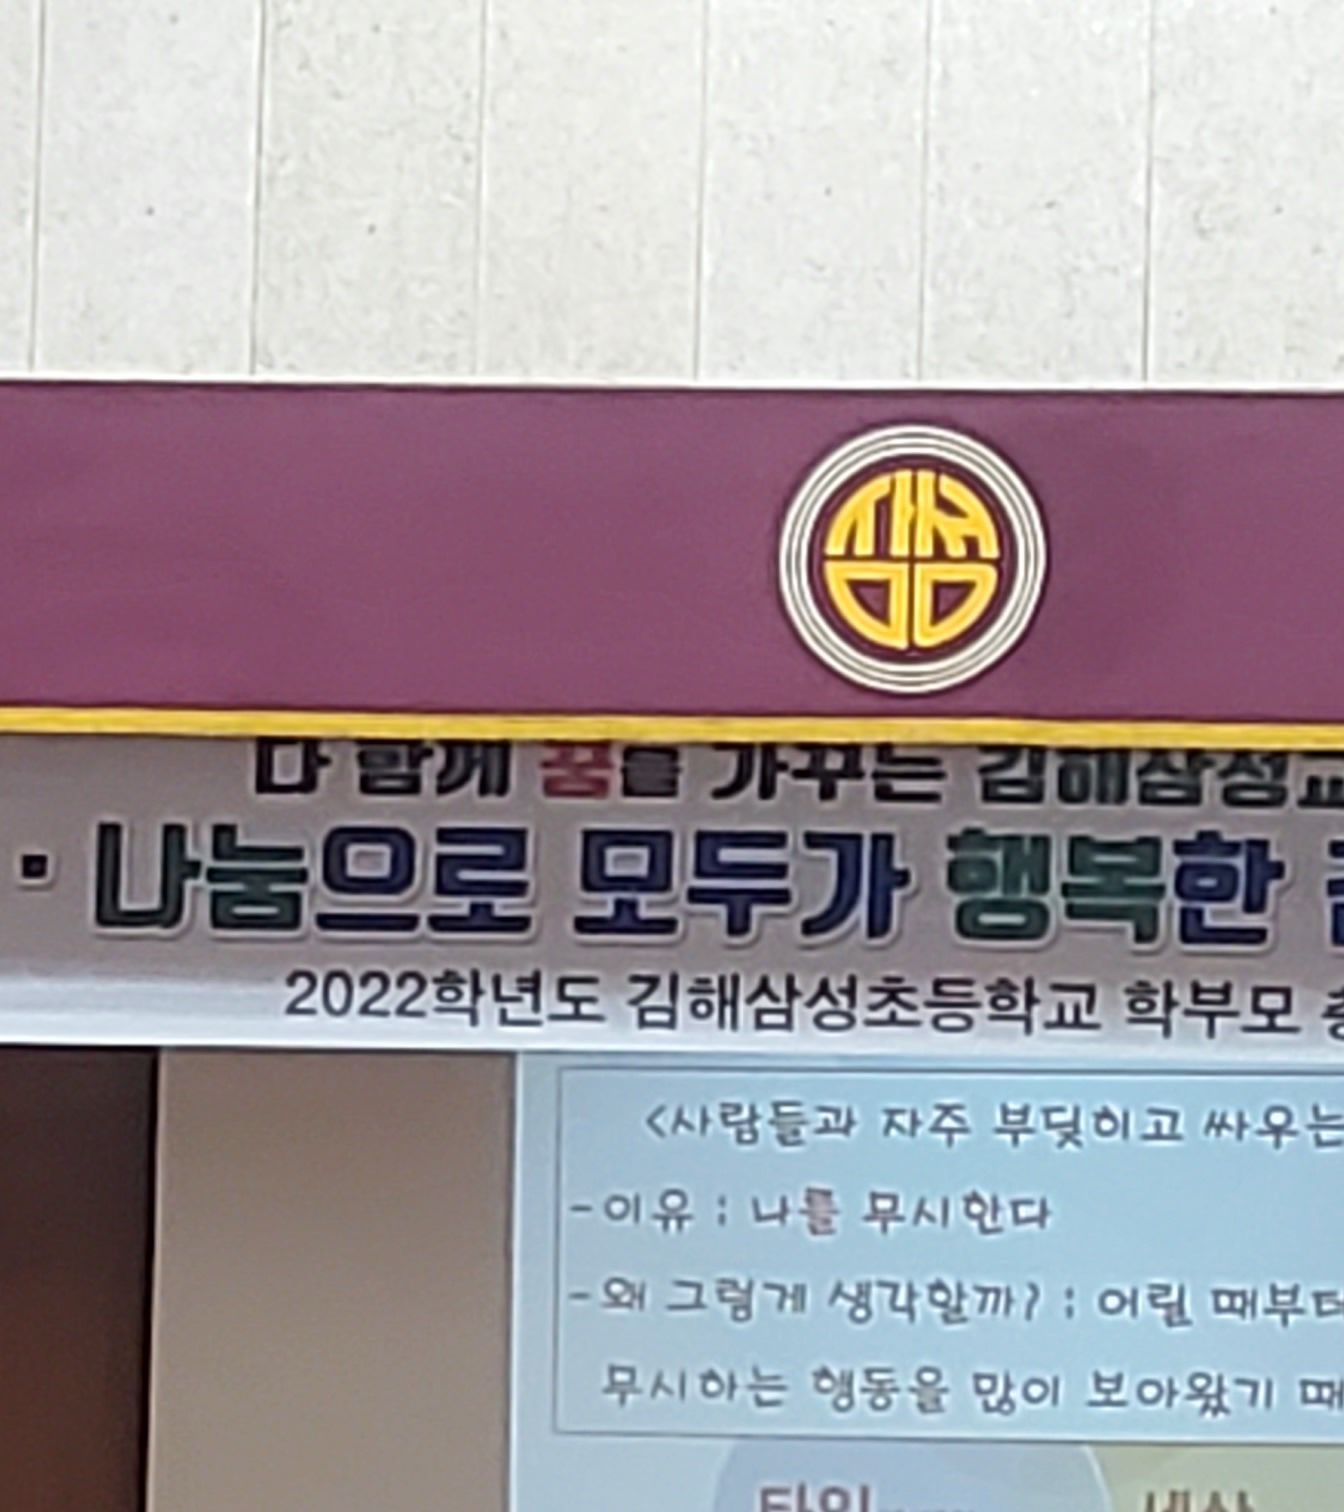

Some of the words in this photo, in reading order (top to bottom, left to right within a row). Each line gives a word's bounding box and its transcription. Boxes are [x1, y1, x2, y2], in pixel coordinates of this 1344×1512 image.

[255, 737, 332, 795] 다
[356, 738, 511, 797] 함께
[711, 742, 947, 802] 가꾸는
[93, 822, 532, 934] 나눔으로
[574, 828, 910, 940] 모두가
[946, 828, 1286, 946] 행복한
[284, 968, 608, 1028] 2022학년도
[627, 971, 1102, 1035] 김해삼성초등학교
[1125, 979, 1301, 1040] 학부모
[883, 1105, 971, 1148] 자주
[752, 1187, 840, 1236] 나를
[862, 1191, 1054, 1235] 무시한다
[665, 1278, 808, 1323] 그렇게
[828, 1280, 1041, 1325] 생각할까?
[1097, 1283, 1193, 1328] 어릴
[602, 1364, 789, 1408] 무시하는
[812, 1364, 950, 1414] 행동을
[973, 1372, 1060, 1415] 많이
[1087, 1371, 1274, 1418] 보아왔기
